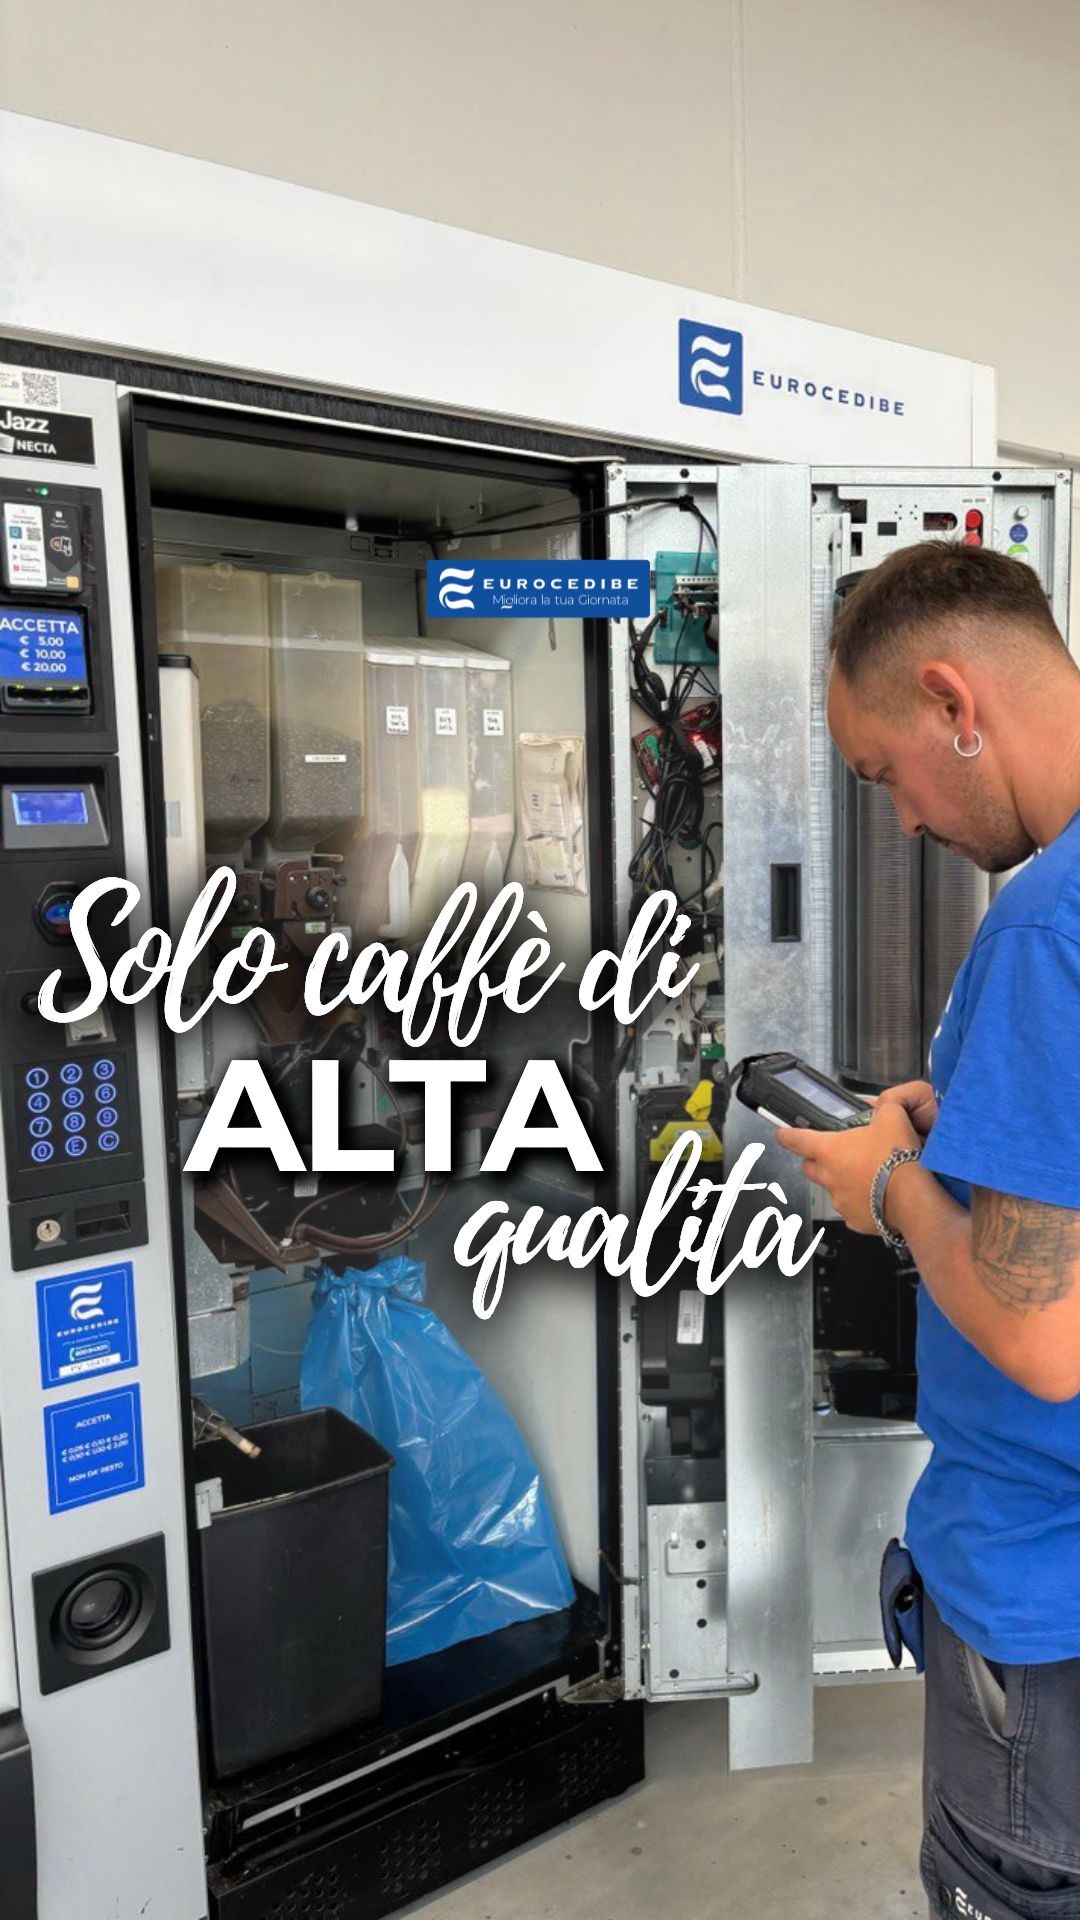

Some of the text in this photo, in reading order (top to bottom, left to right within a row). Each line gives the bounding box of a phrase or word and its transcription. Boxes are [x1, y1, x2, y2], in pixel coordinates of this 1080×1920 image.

[753, 370, 904, 416] EUROCEDIBE
[0, 410, 50, 434] Jazz
[16, 440, 57, 455] NECTA
[0, 618, 79, 634] ACCETTA
[19, 636, 29, 645] €
[20, 648, 30, 658] €
[20, 661, 31, 672] €
[75, 1413, 112, 1429] ACCETTA
[68, 1473, 87, 1483] NON
[99, 1461, 125, 1473] RESTO
